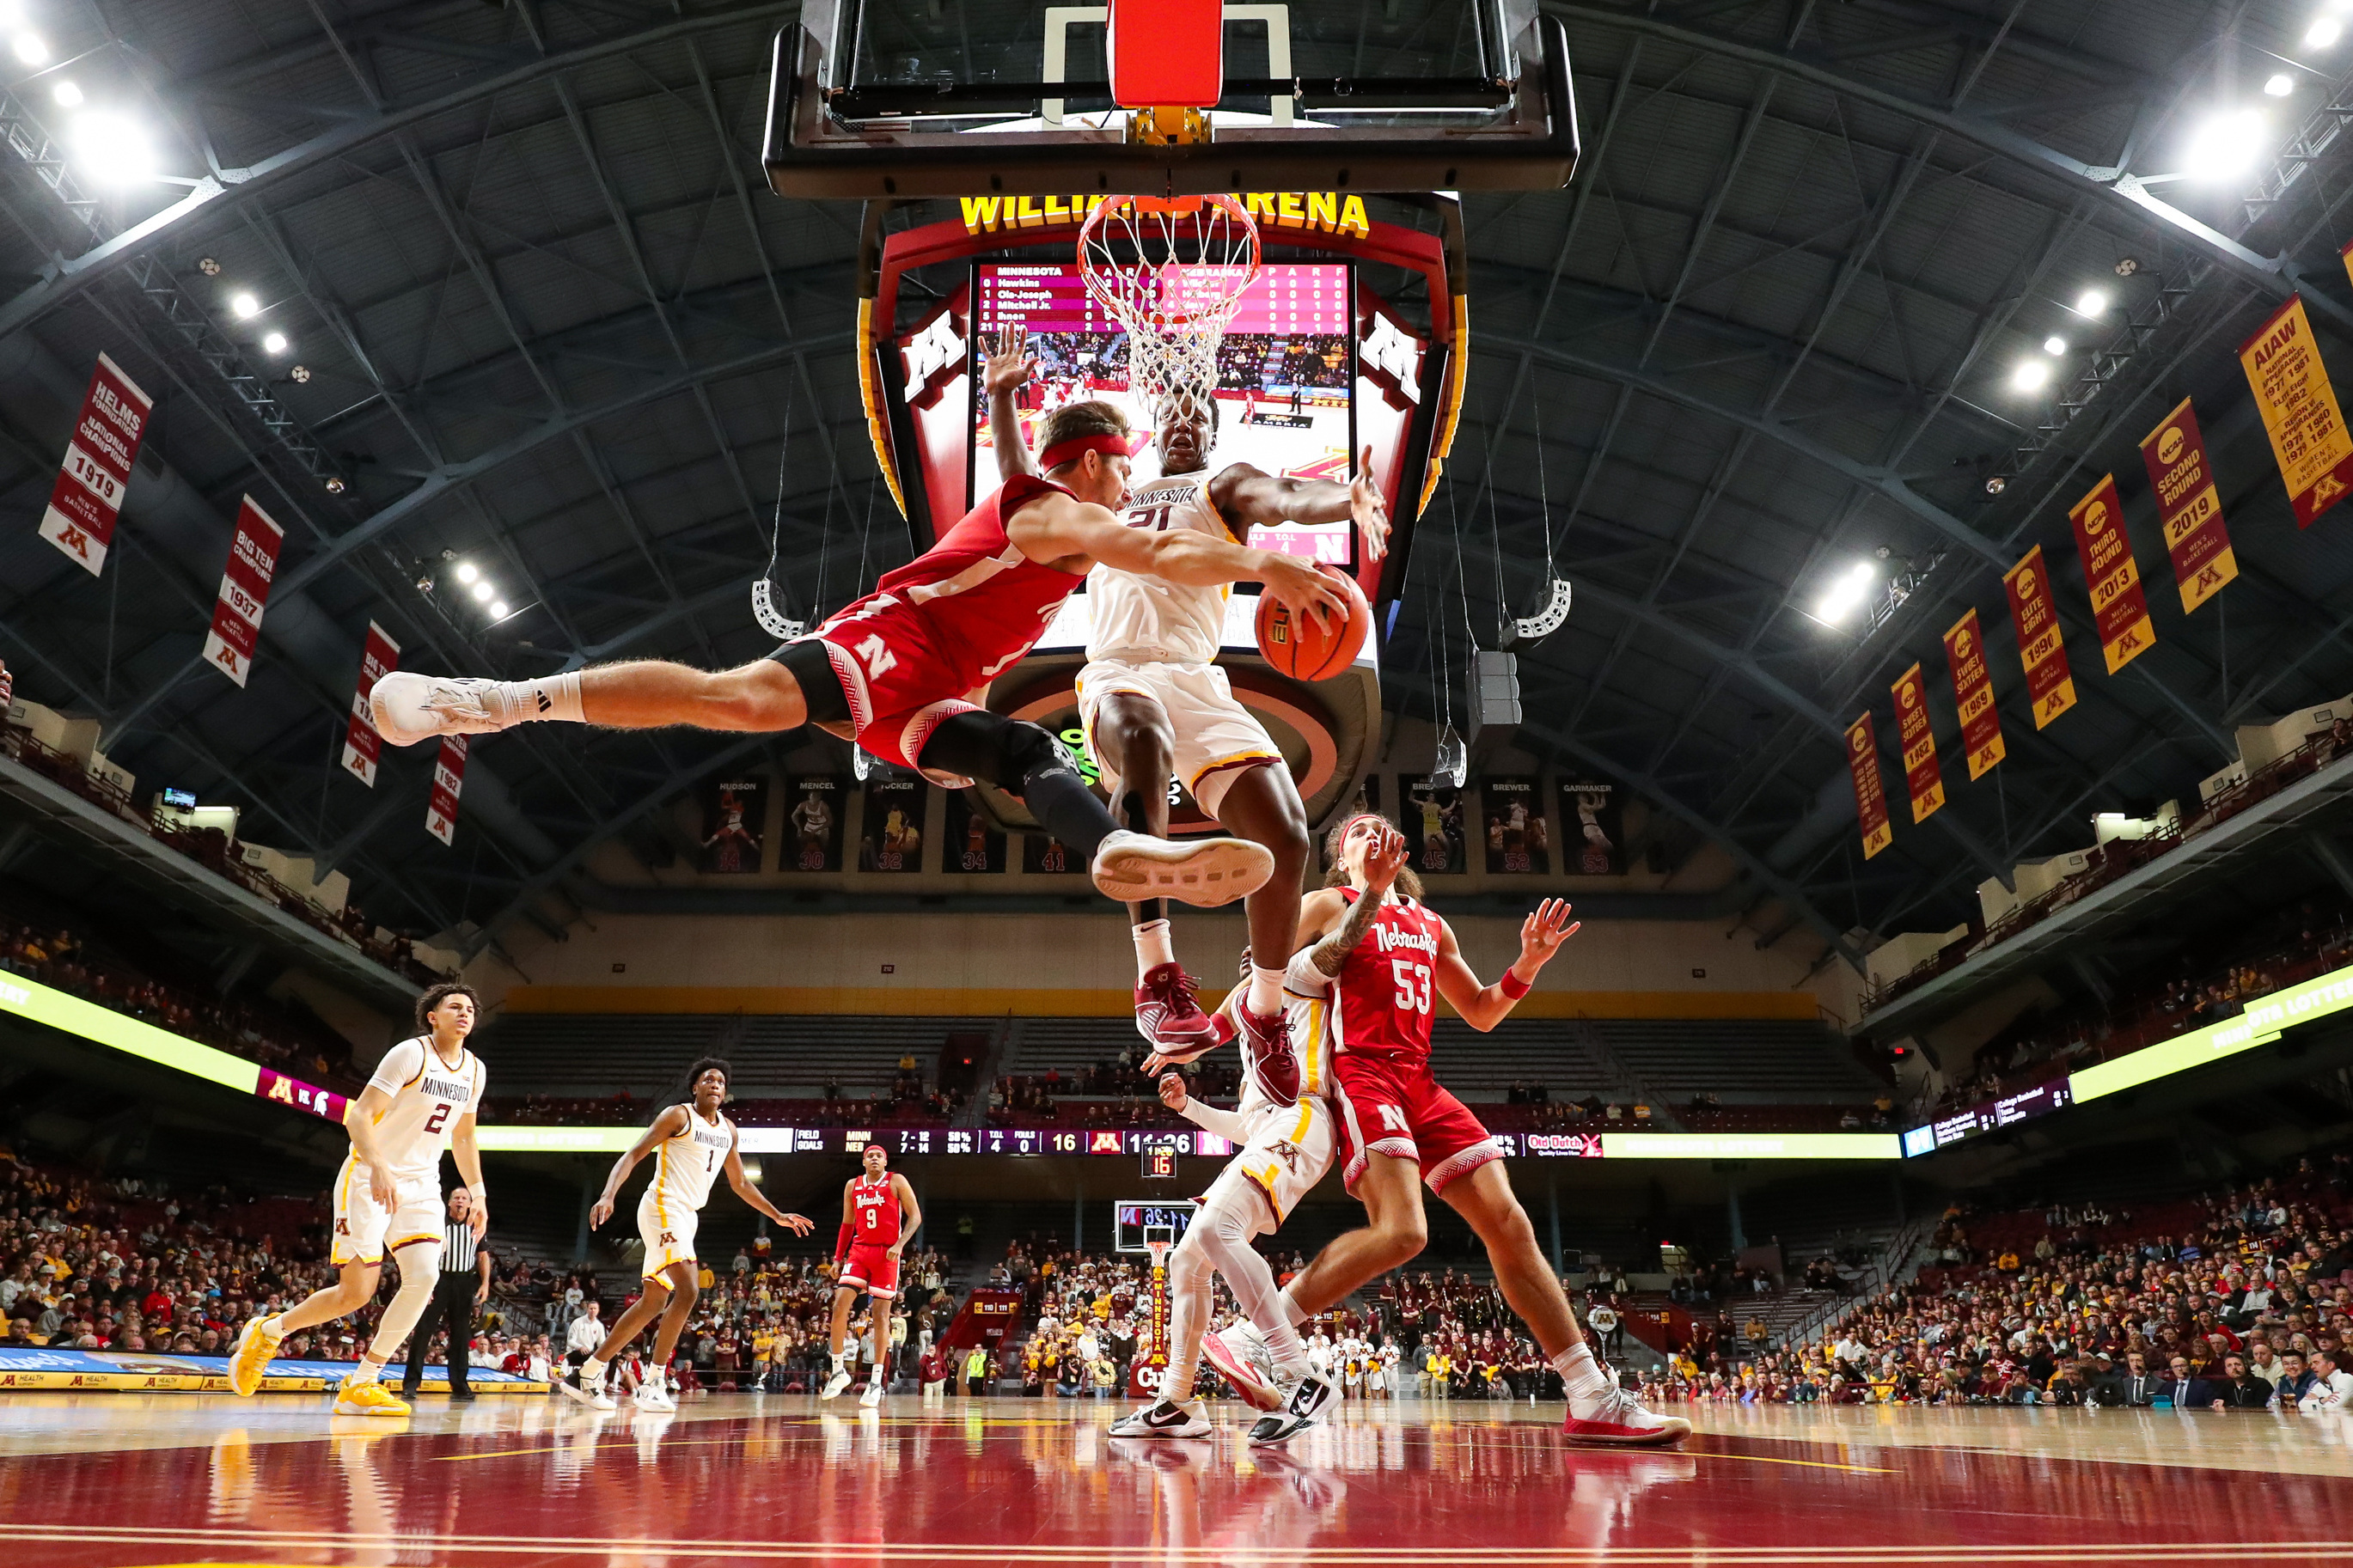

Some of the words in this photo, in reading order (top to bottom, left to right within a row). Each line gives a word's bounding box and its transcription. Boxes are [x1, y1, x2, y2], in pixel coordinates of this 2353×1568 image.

[959, 195, 1131, 235] WILLIA
[983, 278, 991, 288] 0
[997, 278, 1040, 288] Hawkins
[997, 266, 1063, 277] MINNESOTA
[1103, 267, 1113, 277] A
[1126, 267, 1134, 277] R
[1268, 267, 1276, 276] P
[1288, 267, 1297, 276] A
[1312, 267, 1321, 276] R
[1336, 267, 1343, 276] F
[1269, 279, 1277, 288] 0
[1290, 279, 1297, 288] 0
[1313, 279, 1321, 288] 2
[1335, 279, 1342, 288] 0
[983, 301, 990, 309] 2
[997, 301, 1037, 310] Mitchell
[1038, 301, 1051, 310] Jr.
[1085, 301, 1093, 309] 5
[984, 290, 990, 298] 1
[997, 290, 1053, 301] Ola-Joseph
[1168, 301, 1175, 309] 4
[1269, 301, 1277, 309] 0
[1290, 301, 1297, 309] 0
[1315, 301, 1321, 309] 1
[1335, 301, 1342, 309] 0
[1269, 290, 1277, 299] 0
[1290, 290, 1297, 299] 0
[1313, 290, 1321, 299] 0
[1335, 290, 1342, 299] 0
[980, 322, 993, 332] 21
[1085, 323, 1092, 332] 2
[1105, 322, 1112, 332] 1
[983, 312, 990, 320] 5
[997, 312, 1026, 320] Ihnen
[1085, 312, 1093, 320] 0
[1269, 313, 1277, 321] 0
[1290, 313, 1297, 321] 0
[1313, 313, 1321, 321] 0
[1335, 313, 1342, 321] 0
[2253, 316, 2297, 371] AIAW
[2262, 345, 2306, 390] APPEARANCES
[2265, 345, 2296, 375] NATIONAL
[2287, 354, 2310, 378] 1981
[2289, 373, 2310, 393] EIGHT
[95, 381, 141, 431] HELMS
[2285, 388, 2307, 412] 1982
[92, 394, 138, 442] FOUNDATION
[2280, 400, 2325, 442] APPEARANCES
[88, 415, 129, 458] NATIONAL
[2311, 420, 2334, 443] 1981
[80, 422, 131, 472] CHAMPIONS
[2161, 436, 2185, 461] NCAA
[2299, 443, 2332, 473] WOMEN'S
[76, 456, 115, 498] 1919
[2157, 448, 2200, 493] SECOND
[2295, 448, 2339, 485] BASKETBALL
[2164, 467, 2202, 507] ROUND
[64, 495, 102, 529] BASKETBALL
[77, 494, 98, 515] MEN'S
[1126, 506, 1172, 531] 21
[2087, 509, 2107, 531] NCAA
[2172, 497, 2209, 539] 2019
[236, 529, 255, 555] BIG
[256, 545, 274, 573] TEN
[1280, 541, 1289, 553] 4
[2089, 528, 2118, 558] THIRD
[2183, 536, 2218, 567] BASKETBALL
[2188, 534, 2207, 552] MEN'S
[234, 544, 272, 583] CHAMPIONS
[2091, 539, 2123, 575] ROUND
[2098, 569, 2130, 604] 2013
[229, 585, 259, 619] 1937
[2021, 595, 2044, 621] ELITE
[2024, 607, 2046, 635] EIGHT
[2027, 633, 2054, 663] 1990
[365, 651, 378, 672] BIG
[1957, 652, 1980, 680] SWEET
[1957, 663, 1985, 694] SIXTEEN
[1965, 691, 1988, 718] 1989
[1902, 705, 1923, 729] SWEET
[1909, 741, 1930, 765] 1982
[439, 770, 457, 792] 1982
[799, 851, 824, 869] 30
[879, 851, 902, 869] 32
[963, 852, 987, 870] 34
[1042, 852, 1065, 871] 41
[1421, 851, 1446, 869] 45
[1505, 853, 1531, 871] 52
[1583, 853, 1609, 873] 53
[1371, 922, 1438, 961] Nebraska
[1391, 958, 1431, 1016] 53
[420, 1077, 469, 1103] MINNESOTA
[2017, 1087, 2044, 1102] Basketball
[424, 1102, 452, 1135] 2
[694, 1130, 730, 1150] MINNESOTA
[797, 1140, 823, 1150] GOALS
[798, 1130, 820, 1139] FIELD
[846, 1131, 872, 1141] MINN
[901, 1131, 908, 1141] 7
[919, 1131, 930, 1141] 12
[990, 1140, 1000, 1152] 4
[1019, 1139, 1030, 1152] 0
[1053, 1133, 1076, 1151] 16
[1529, 1135, 1549, 1148] Old
[1550, 1135, 1581, 1149] Dutch
[846, 1142, 865, 1152] NEB
[901, 1143, 908, 1153] 7
[919, 1143, 929, 1153] 14
[706, 1150, 714, 1172] 1
[1154, 1156, 1170, 1174] 16
[855, 1191, 885, 1209] Nebraska
[866, 1208, 877, 1229] 9
[1154, 1283, 1163, 1351] MINNESOTA
